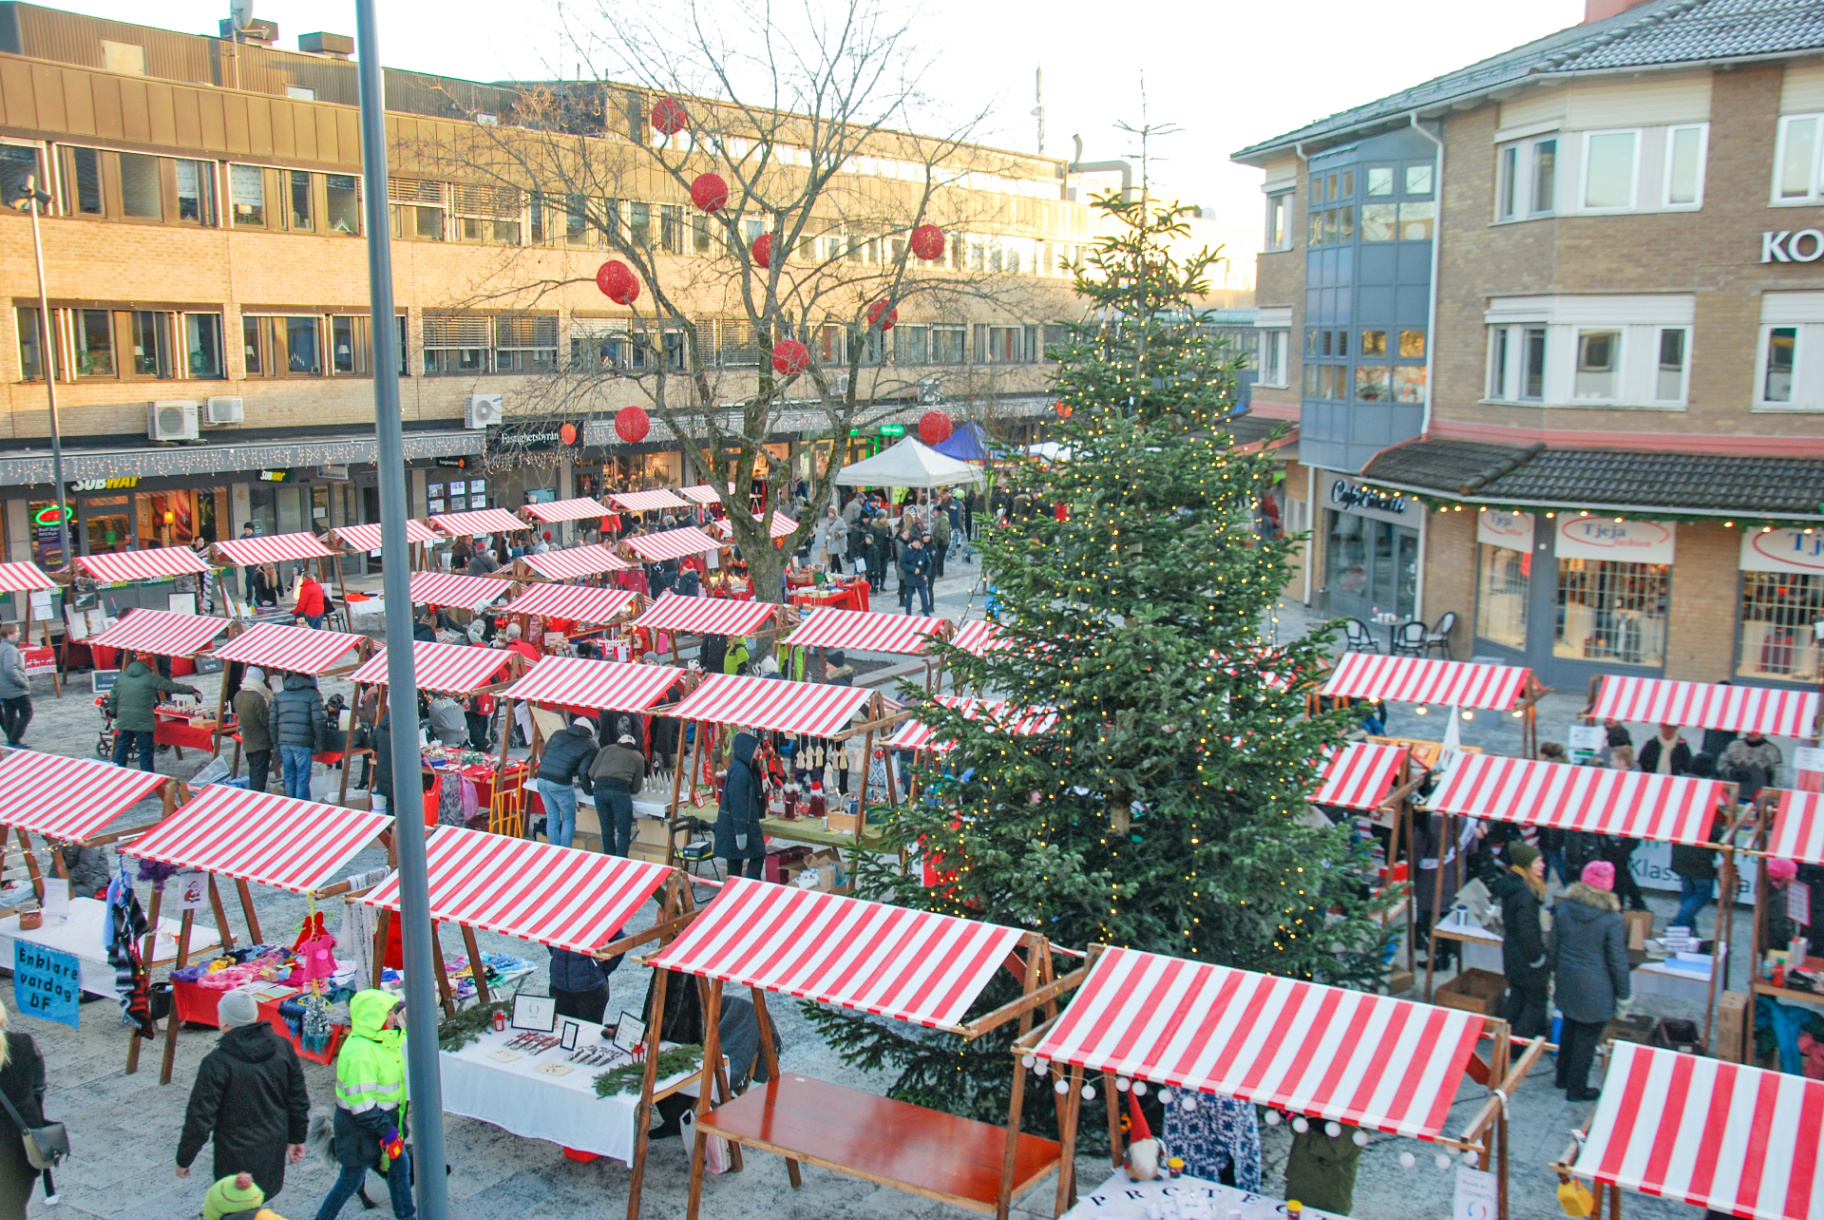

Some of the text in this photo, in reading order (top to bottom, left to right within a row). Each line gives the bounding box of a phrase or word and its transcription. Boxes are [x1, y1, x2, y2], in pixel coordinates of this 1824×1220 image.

[1760, 229, 1824, 264] KO
[71, 476, 138, 492] SUBWAY
[1582, 523, 1627, 539] Tjeja
[1787, 531, 1824, 557] Tj
[18, 947, 79, 981] Enklare
[20, 973, 72, 1002] vardag
